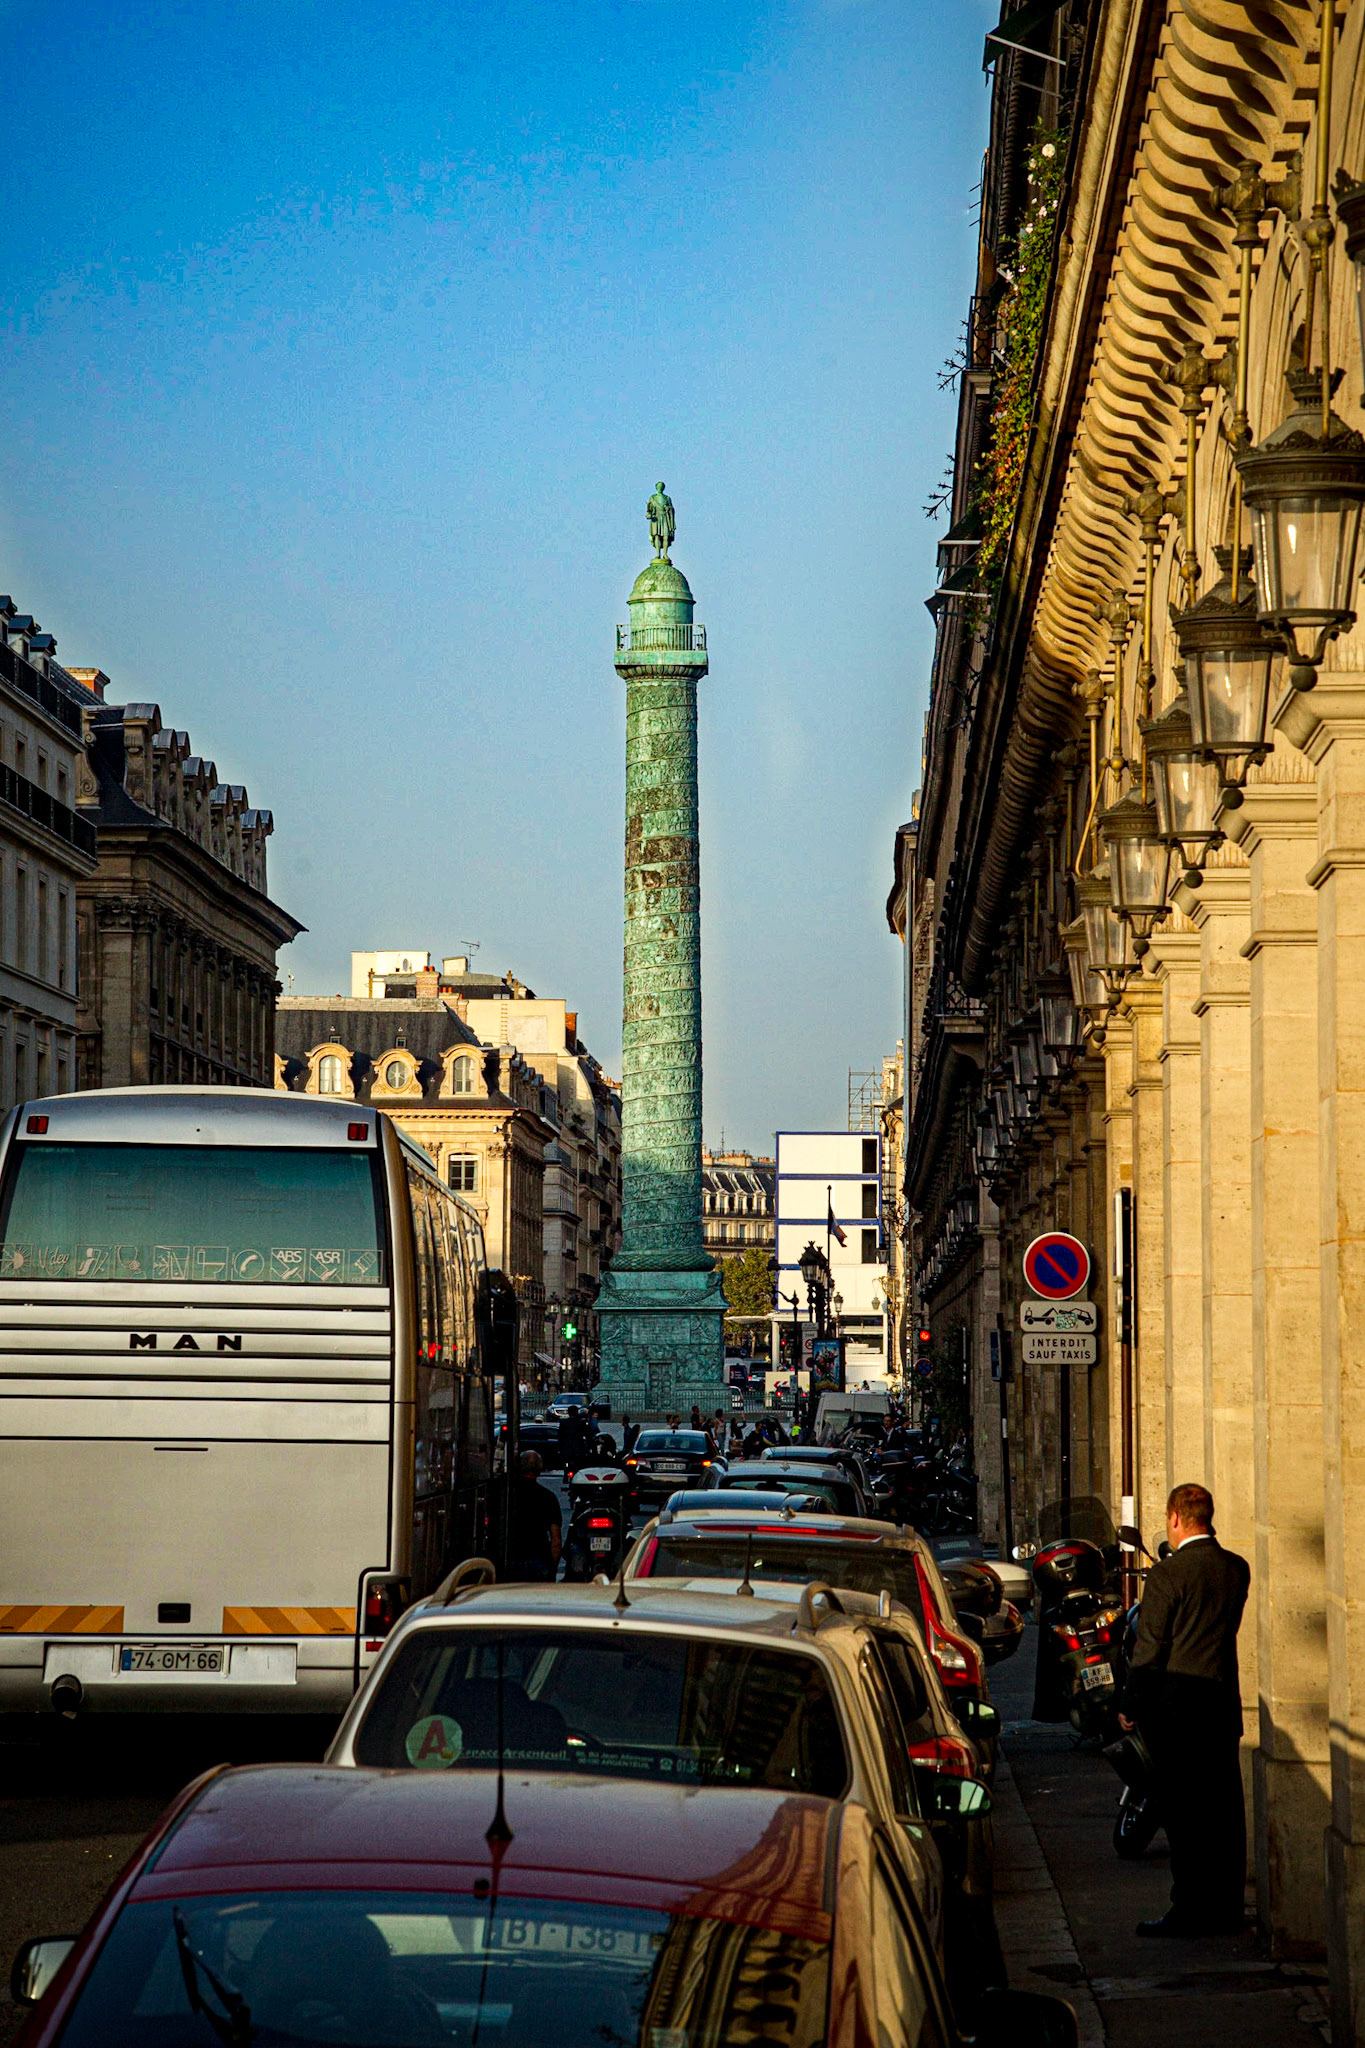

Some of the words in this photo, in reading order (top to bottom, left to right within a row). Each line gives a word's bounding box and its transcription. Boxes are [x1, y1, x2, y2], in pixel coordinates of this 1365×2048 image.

[277, 1251, 302, 1263] ABS
[315, 1251, 341, 1264] ASR
[129, 1333, 242, 1350] MAN
[1032, 1339, 1087, 1347] INTERDIT
[1029, 1351, 1056, 1359] SAUF
[1061, 1351, 1091, 1359] TAXIS
[417, 1719, 452, 1760] A
